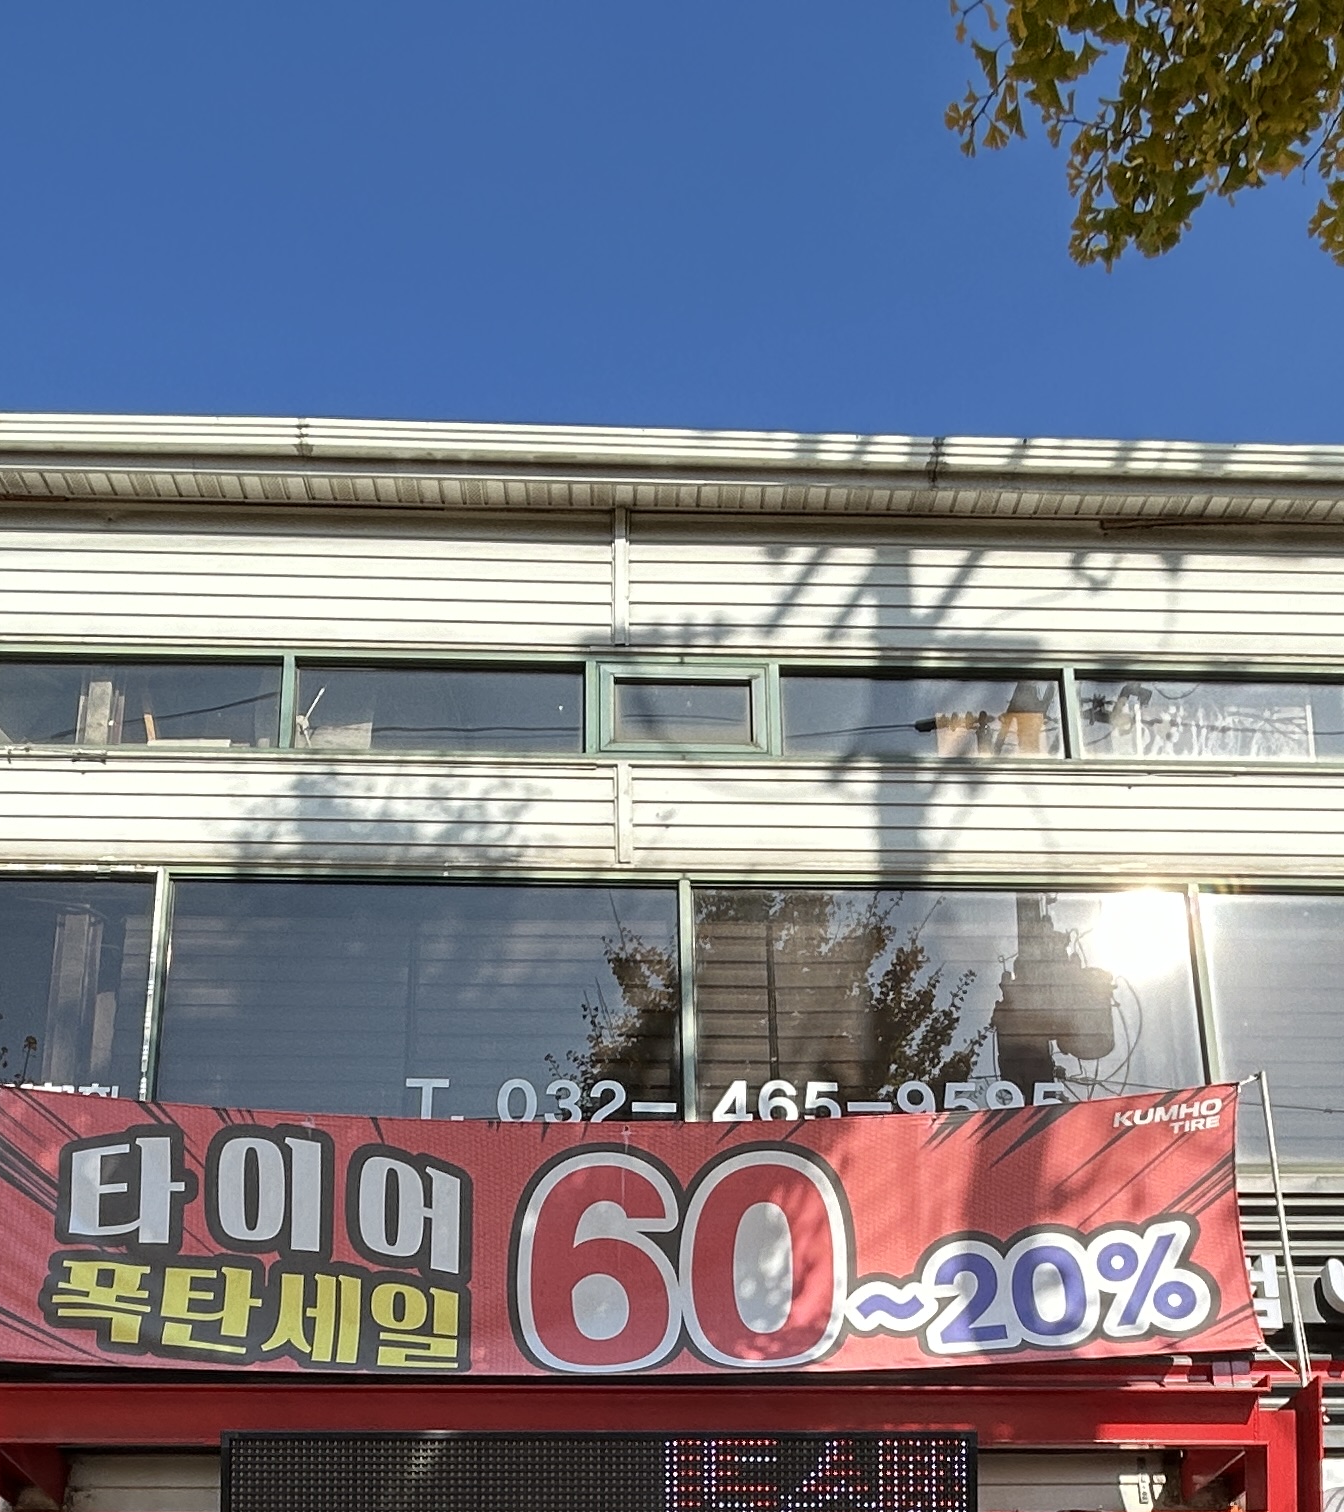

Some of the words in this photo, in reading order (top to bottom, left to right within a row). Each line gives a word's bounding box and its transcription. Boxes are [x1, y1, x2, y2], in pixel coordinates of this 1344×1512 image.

[1112, 1098, 1223, 1129] KUMHO
[1169, 1115, 1221, 1135] TIRE
[65, 1130, 466, 1275] 타이어
[54, 1258, 464, 1370] 폭탄세일
